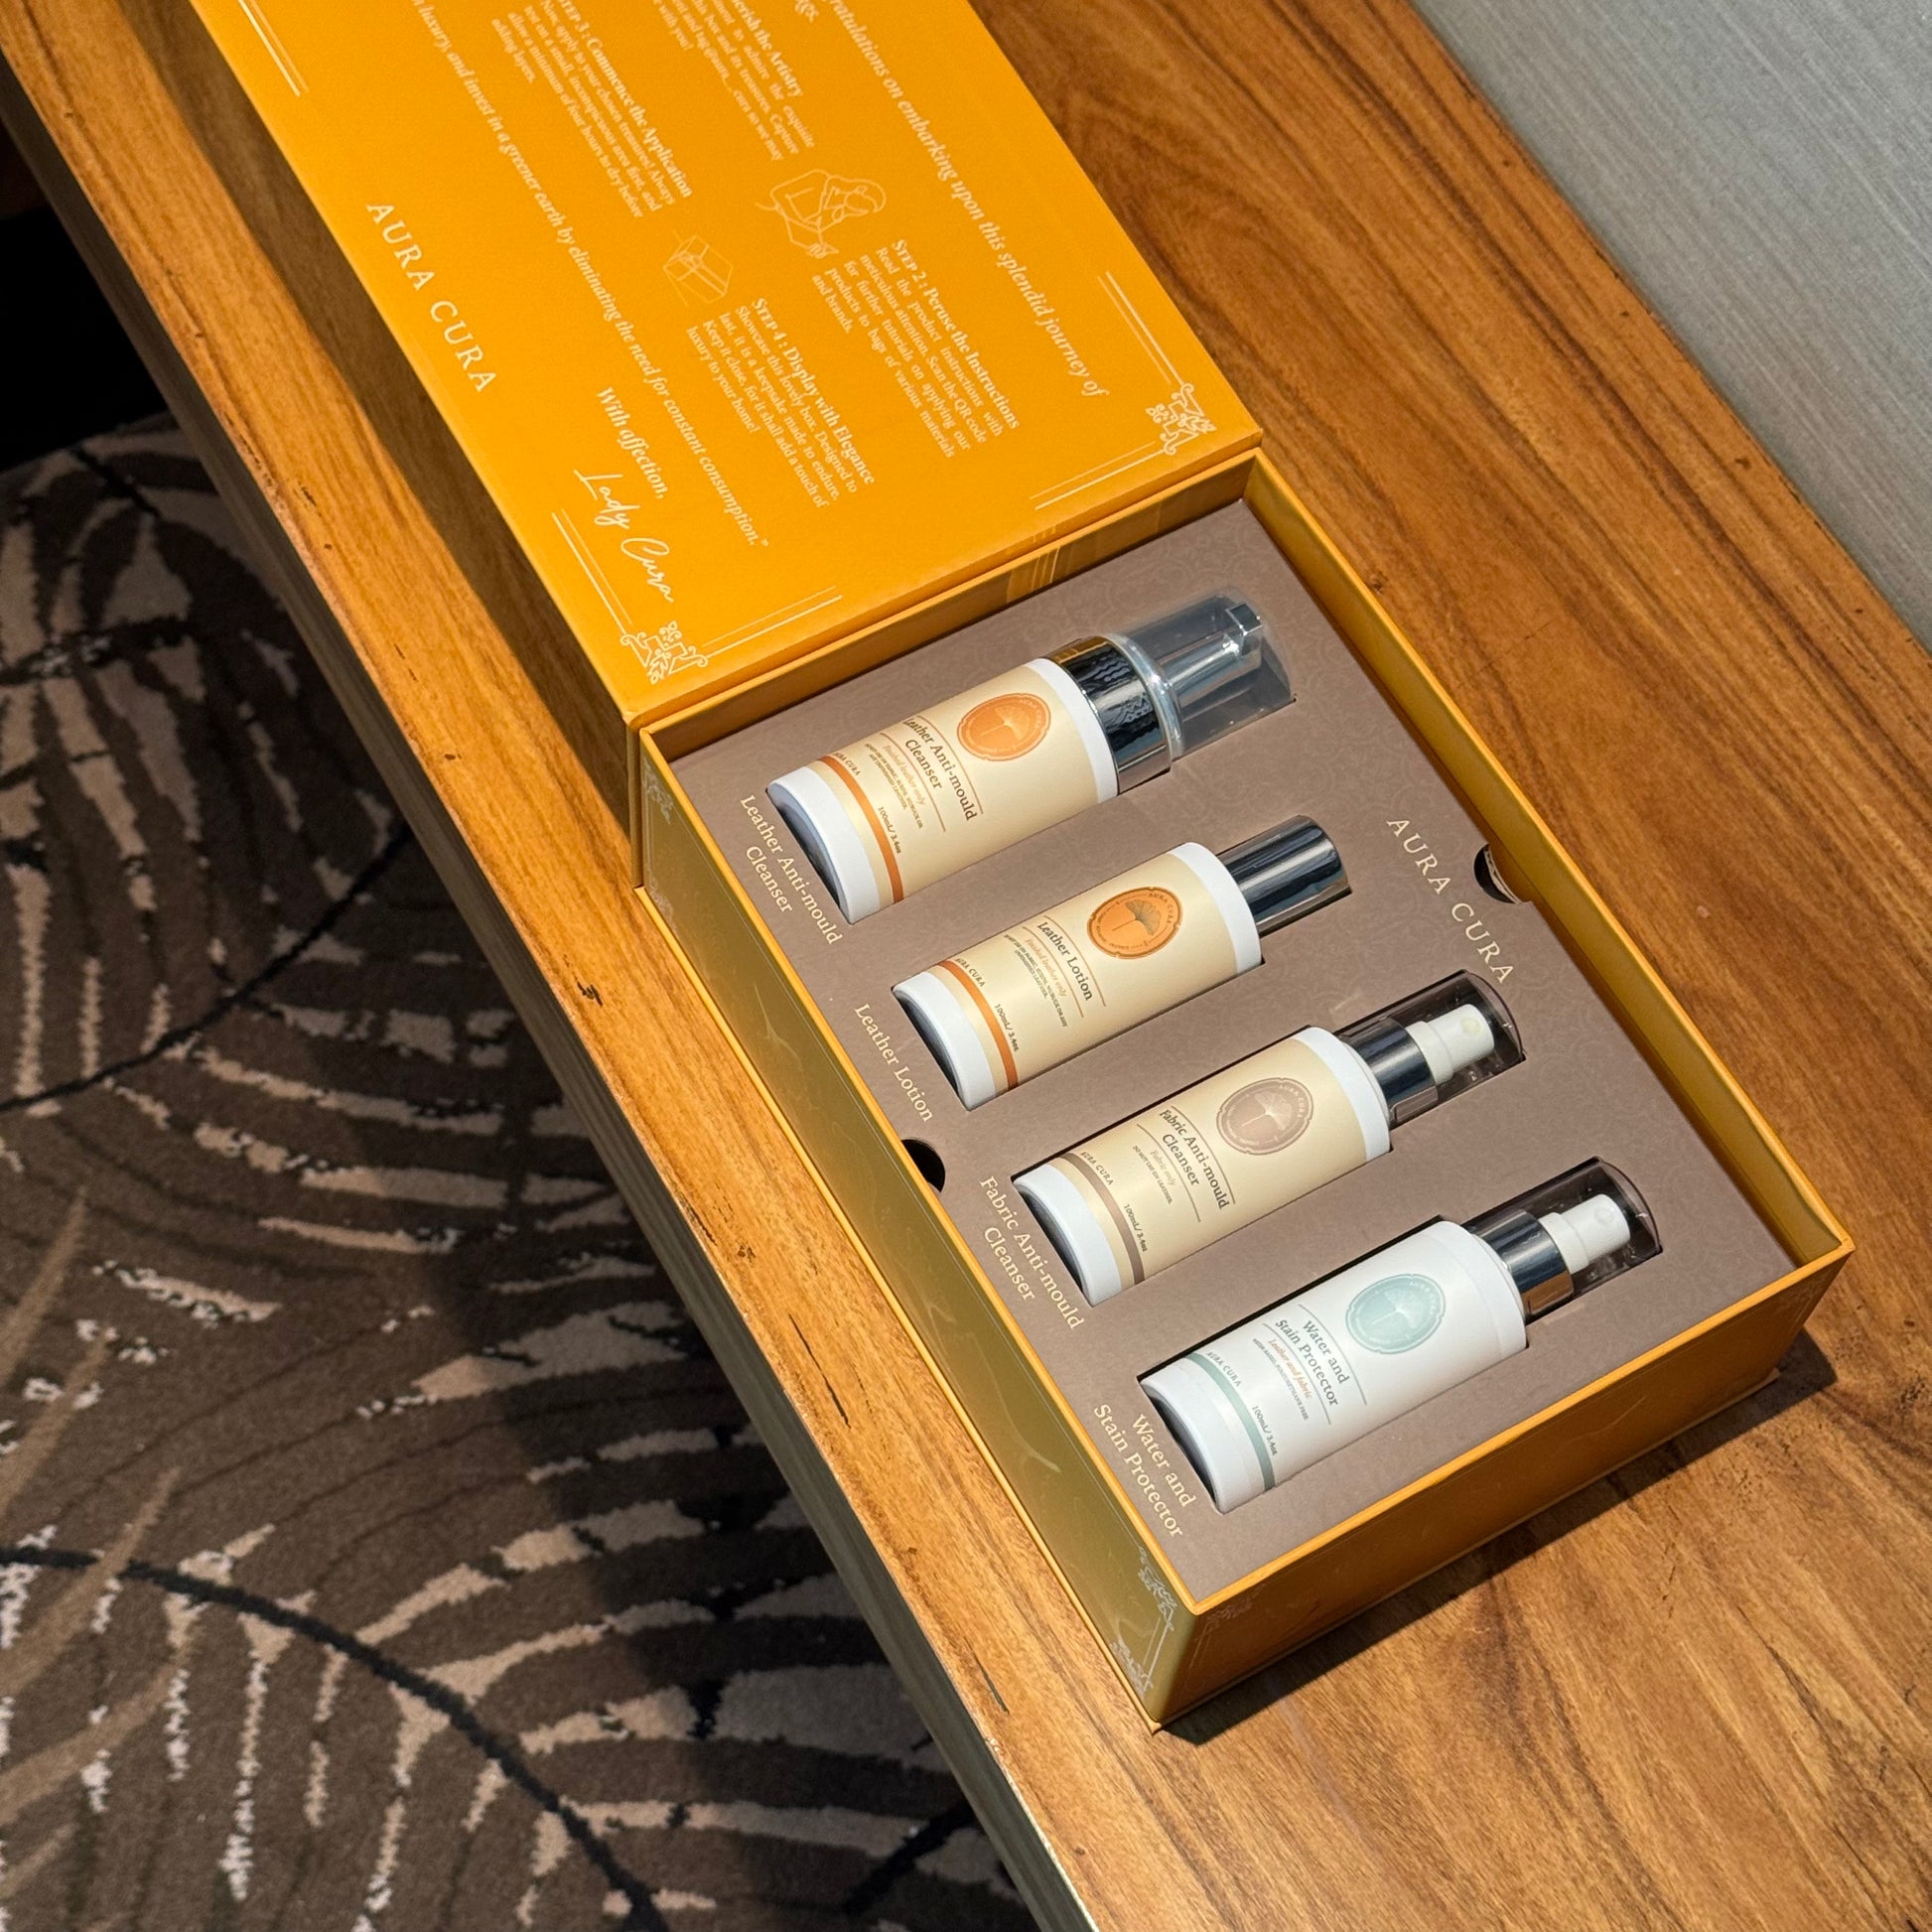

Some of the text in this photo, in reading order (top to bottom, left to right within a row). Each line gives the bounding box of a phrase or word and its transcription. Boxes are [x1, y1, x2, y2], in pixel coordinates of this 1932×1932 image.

[418, 5, 452, 52] luxury,
[558, 0, 581, 22] TEP
[731, 0, 761, 31] erish
[446, 52, 476, 78] and
[464, 77, 495, 115] invest
[486, 115, 503, 131] in
[496, 131, 510, 144] a
[498, 142, 542, 191] greener
[534, 191, 566, 227] earth
[556, 225, 575, 244] by
[829, 0, 1110, 396] ratulations on embarking upon this splendid journey of
[365, 205, 496, 392] AURA CURA
[568, 245, 622, 322] eliminating
[811, 274, 853, 334] and brands.
[615, 320, 635, 342] the
[628, 343, 661, 376] need
[824, 267, 955, 458] products to bags of various materials
[844, 260, 971, 450] for further tutorials on applying our
[860, 254, 987, 443] meticulous attention. Scan the QR code
[876, 246, 1004, 437] Read the product instructions with
[893, 238, 1020, 429] STEP 2 Peruse the Instructions
[642, 375, 670, 396] for
[686, 325, 761, 433] luxury to your home!
[702, 319, 829, 507] Keep it close, for it shall add a touch of
[719, 312, 840, 500] last, it is a keepsake made to endure.
[736, 305, 858, 492] Showcase this lovely box. Designed to
[751, 297, 875, 483] STEP 4 Display with Elegance
[597, 386, 668, 498] With affection,
[662, 398, 707, 455] constant
[573, 470, 674, 604] Lady Cura
[901, 718, 977, 821] Leather Anti-mould
[904, 740, 942, 789] Cleanser
[740, 794, 843, 944] Leather Anti-mould
[746, 846, 792, 912] Cleanser
[1386, 820, 1513, 984] AURA CURA
[1036, 921, 1070, 956] Leather
[1066, 957, 1092, 1002] Lotion
[854, 1003, 932, 1122] Leather Lotion
[1159, 1109, 1186, 1136] Fabric
[1182, 1137, 1230, 1210] Anti-mould
[1162, 1134, 1199, 1186] Cleanser
[979, 1175, 1085, 1329] Fabric Anti-mould
[984, 1227, 1035, 1301] Cleanser
[1274, 1319, 1301, 1345] Stain
[1298, 1344, 1338, 1407] Protector
[1303, 1320, 1350, 1385] Water and
[1093, 1404, 1182, 1537] Stain Protector
[1132, 1413, 1196, 1507] Water and
